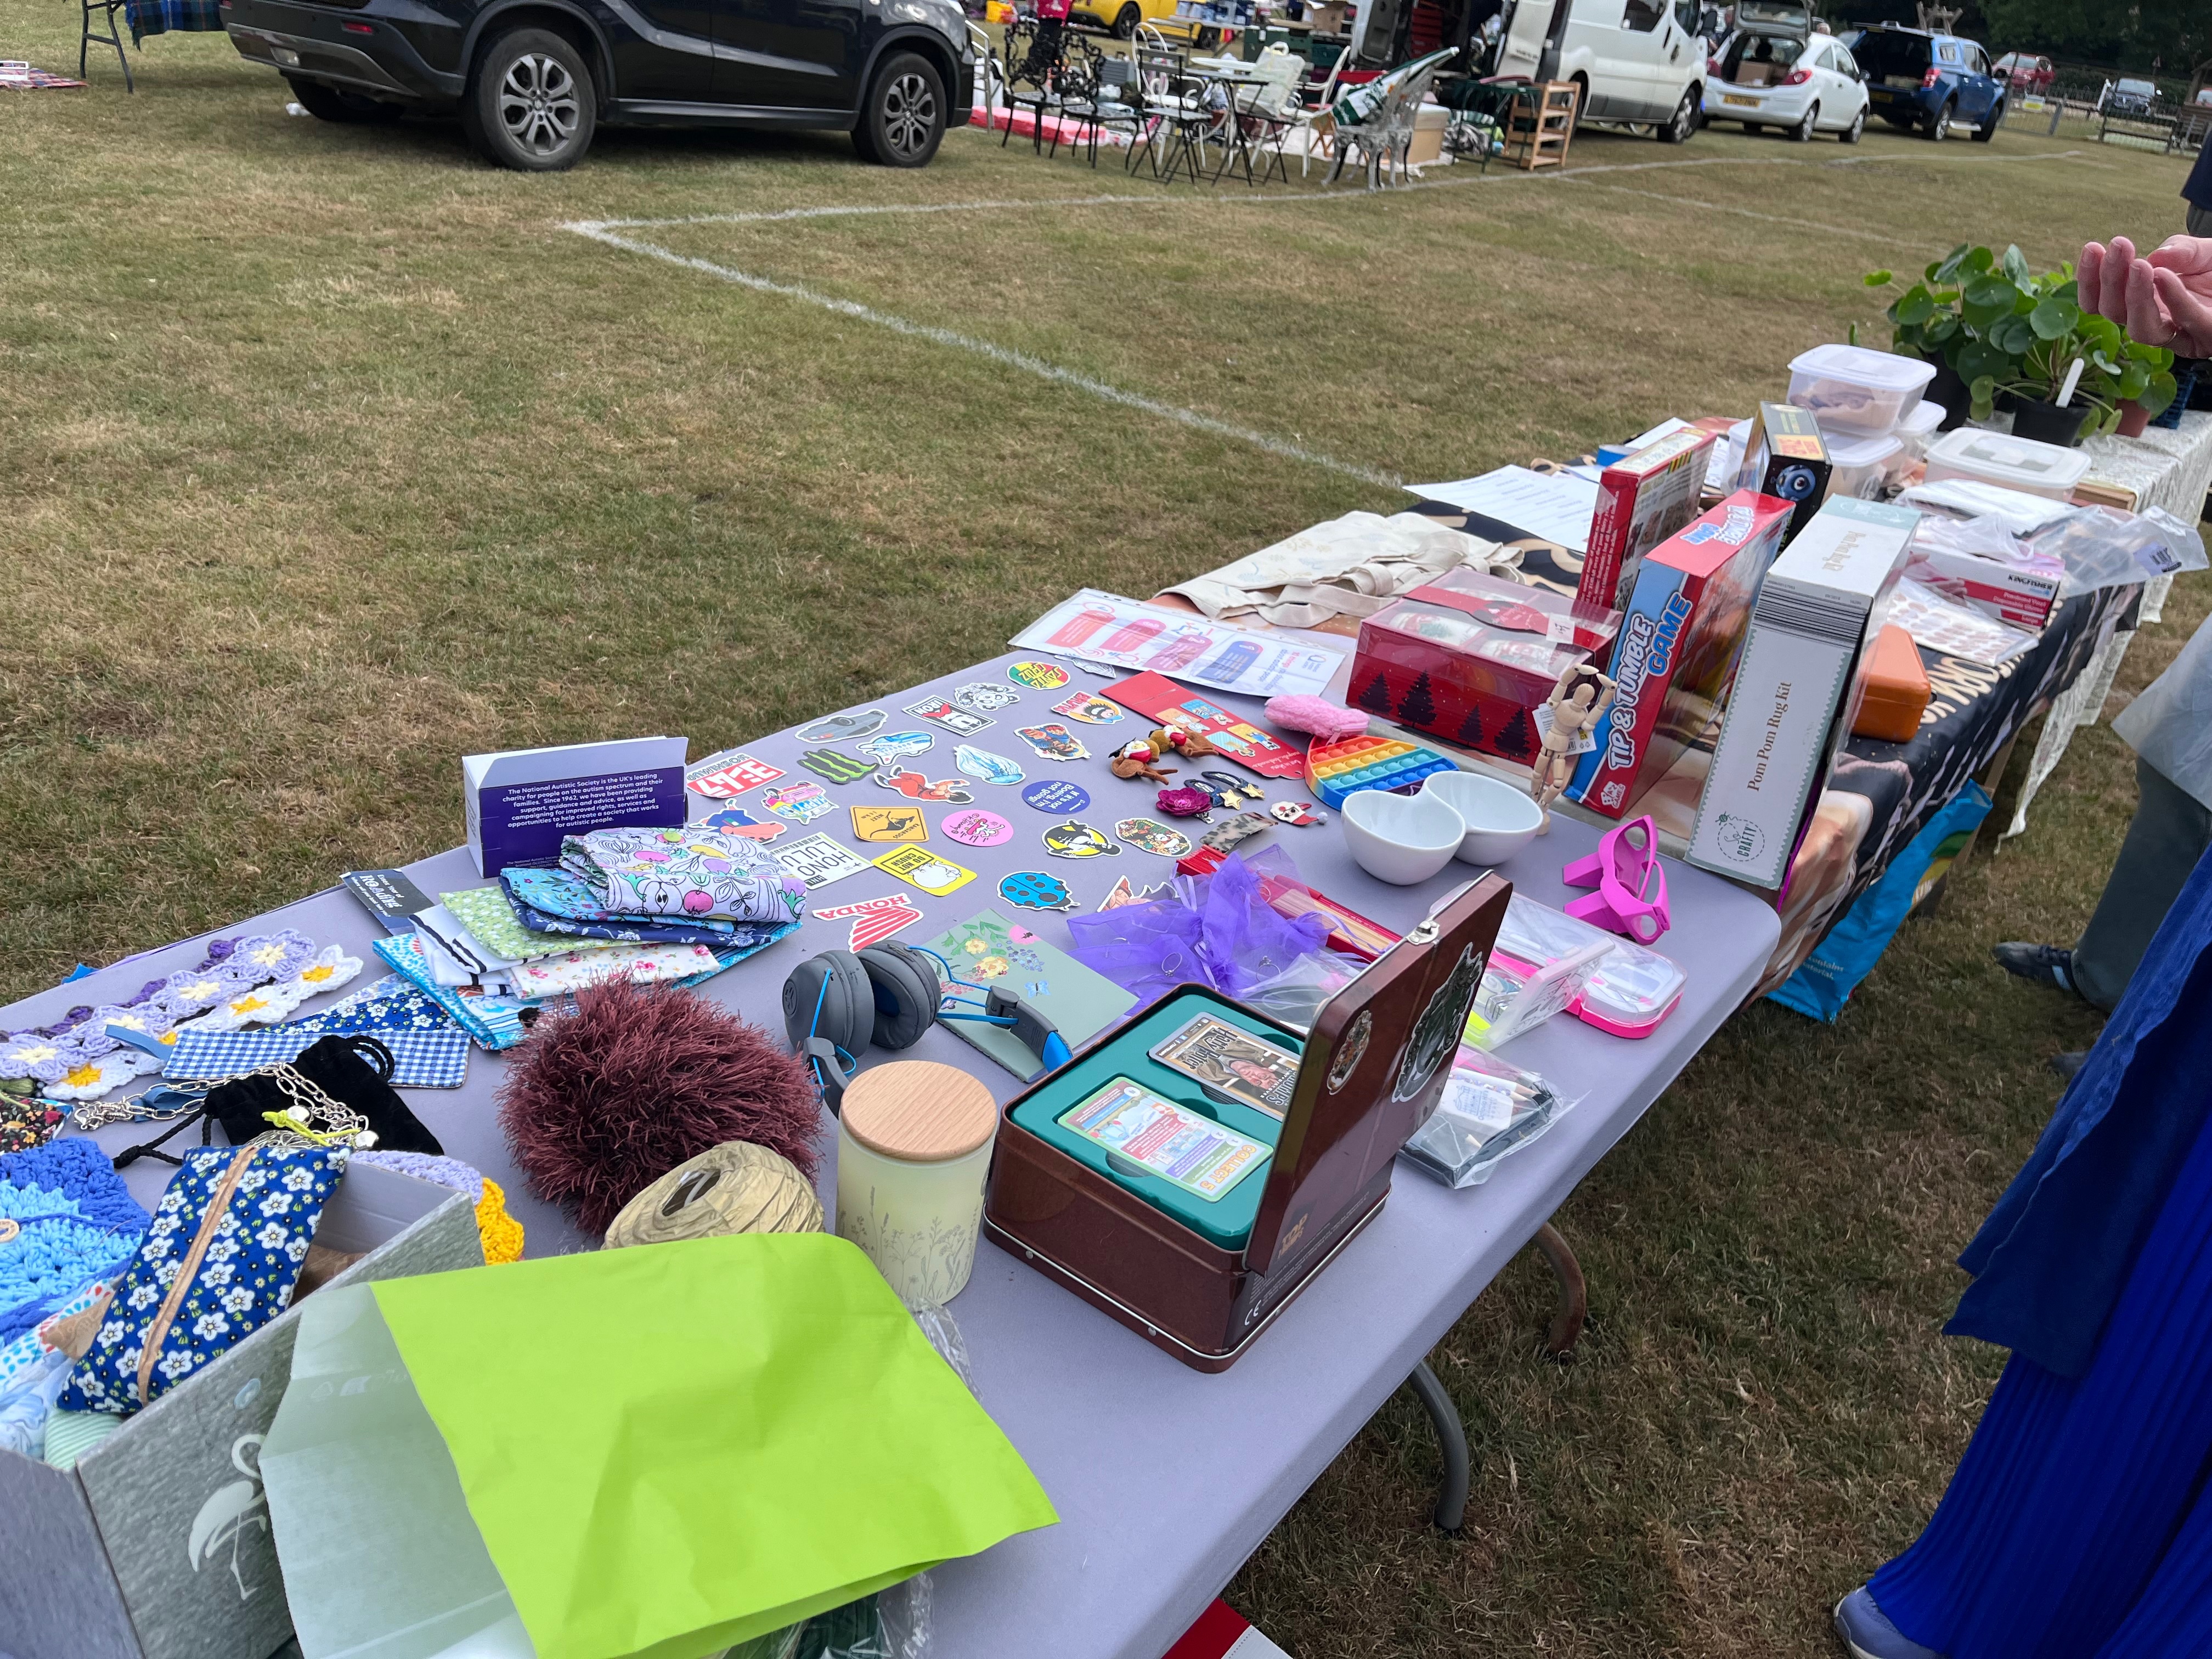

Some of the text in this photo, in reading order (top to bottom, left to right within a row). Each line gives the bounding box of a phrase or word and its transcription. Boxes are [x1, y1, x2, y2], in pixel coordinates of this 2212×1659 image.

[1646, 591, 1692, 676] GAME
[1018, 663, 1046, 681] CRUZ
[1030, 667, 1062, 689] SANTA
[1608, 613, 1655, 770] TIP & TUMBLE
[1747, 681, 1792, 792] Pom Pom Rug Kit
[522, 785, 550, 793] National
[605, 783, 634, 791] spectrum
[1028, 782, 1062, 803] not going!
[1613, 784, 1626, 809] GAMES
[511, 811, 554, 821] campaigning
[566, 805, 595, 814] improved
[549, 802, 579, 811] guidance
[1048, 800, 1062, 809] not
[507, 817, 552, 828] opportunities
[591, 816, 614, 825] people.
[871, 813, 885, 822] NEXT
[1737, 827, 1757, 857] CRAFTY
[781, 841, 837, 867] LULU
[797, 851, 853, 876] HONO
[890, 853, 917, 867] CRUSH
[898, 862, 915, 871] NOT
[377, 874, 390, 885] Essex
[388, 885, 398, 894] Year
[816, 895, 907, 919] HONDA
[1203, 1026, 1239, 1051] Harry
[1182, 1042, 1222, 1070] Potter
[1206, 1142, 1259, 1184] COLLECT
[1198, 1179, 1216, 1192] 5
